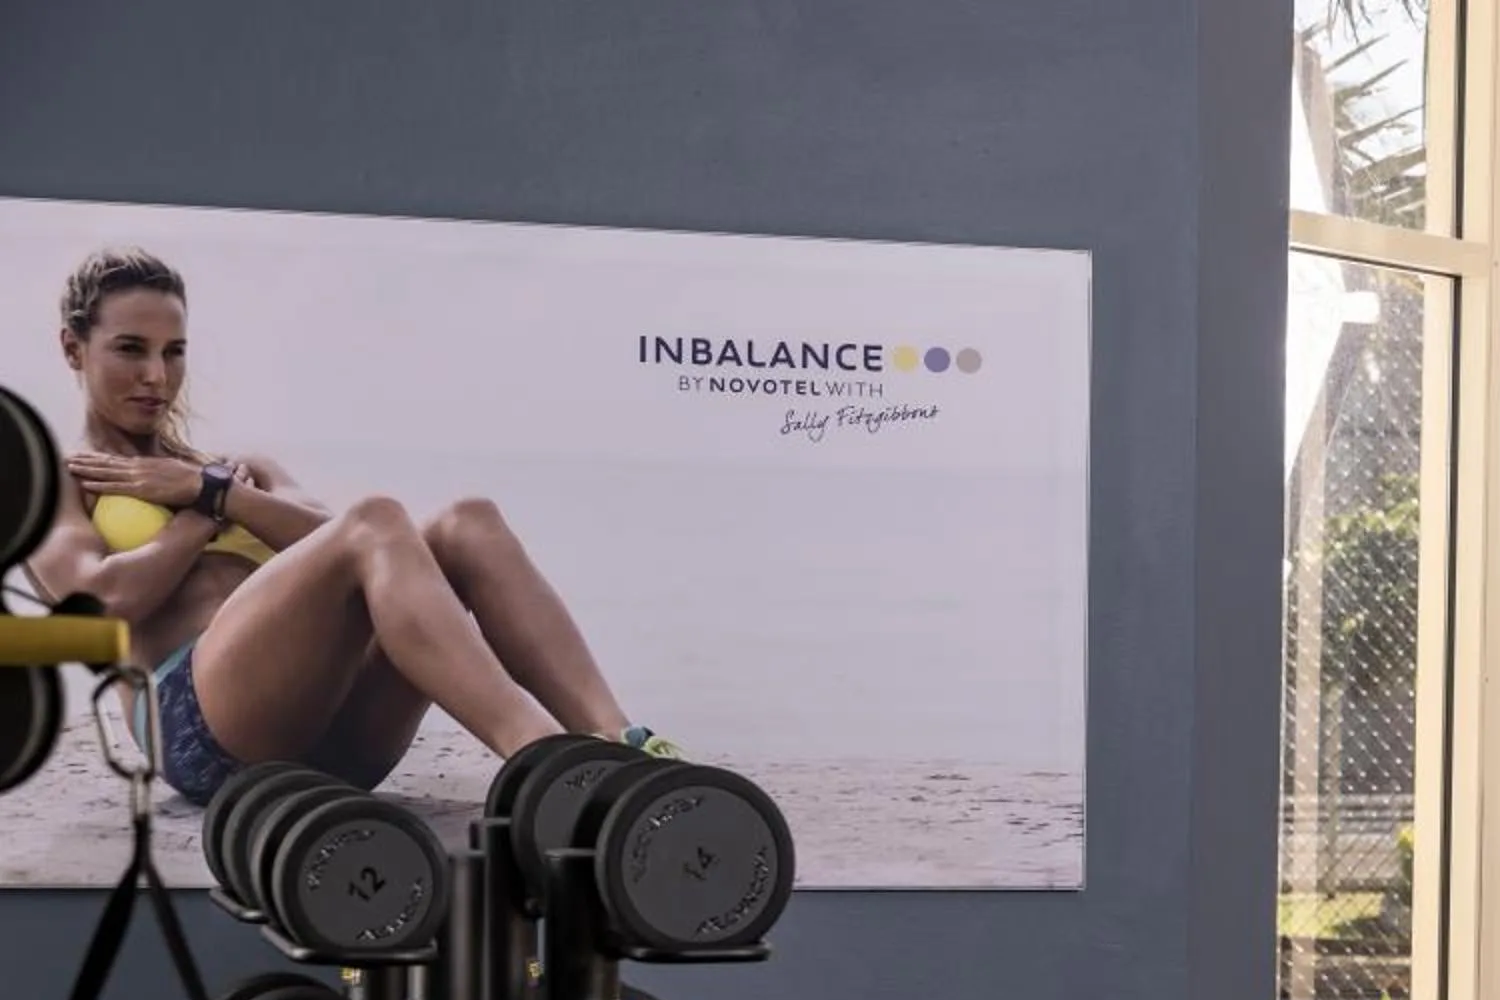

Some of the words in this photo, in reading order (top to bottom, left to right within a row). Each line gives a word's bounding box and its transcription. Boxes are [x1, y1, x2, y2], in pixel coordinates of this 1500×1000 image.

[639, 335, 883, 372] INBALANCE
[679, 375, 704, 391] BY
[709, 377, 821, 396] NOVOTEL
[826, 381, 883, 398] WITH
[780, 409, 829, 442] Sally
[682, 846, 721, 882] 14
[347, 866, 387, 902] 12
